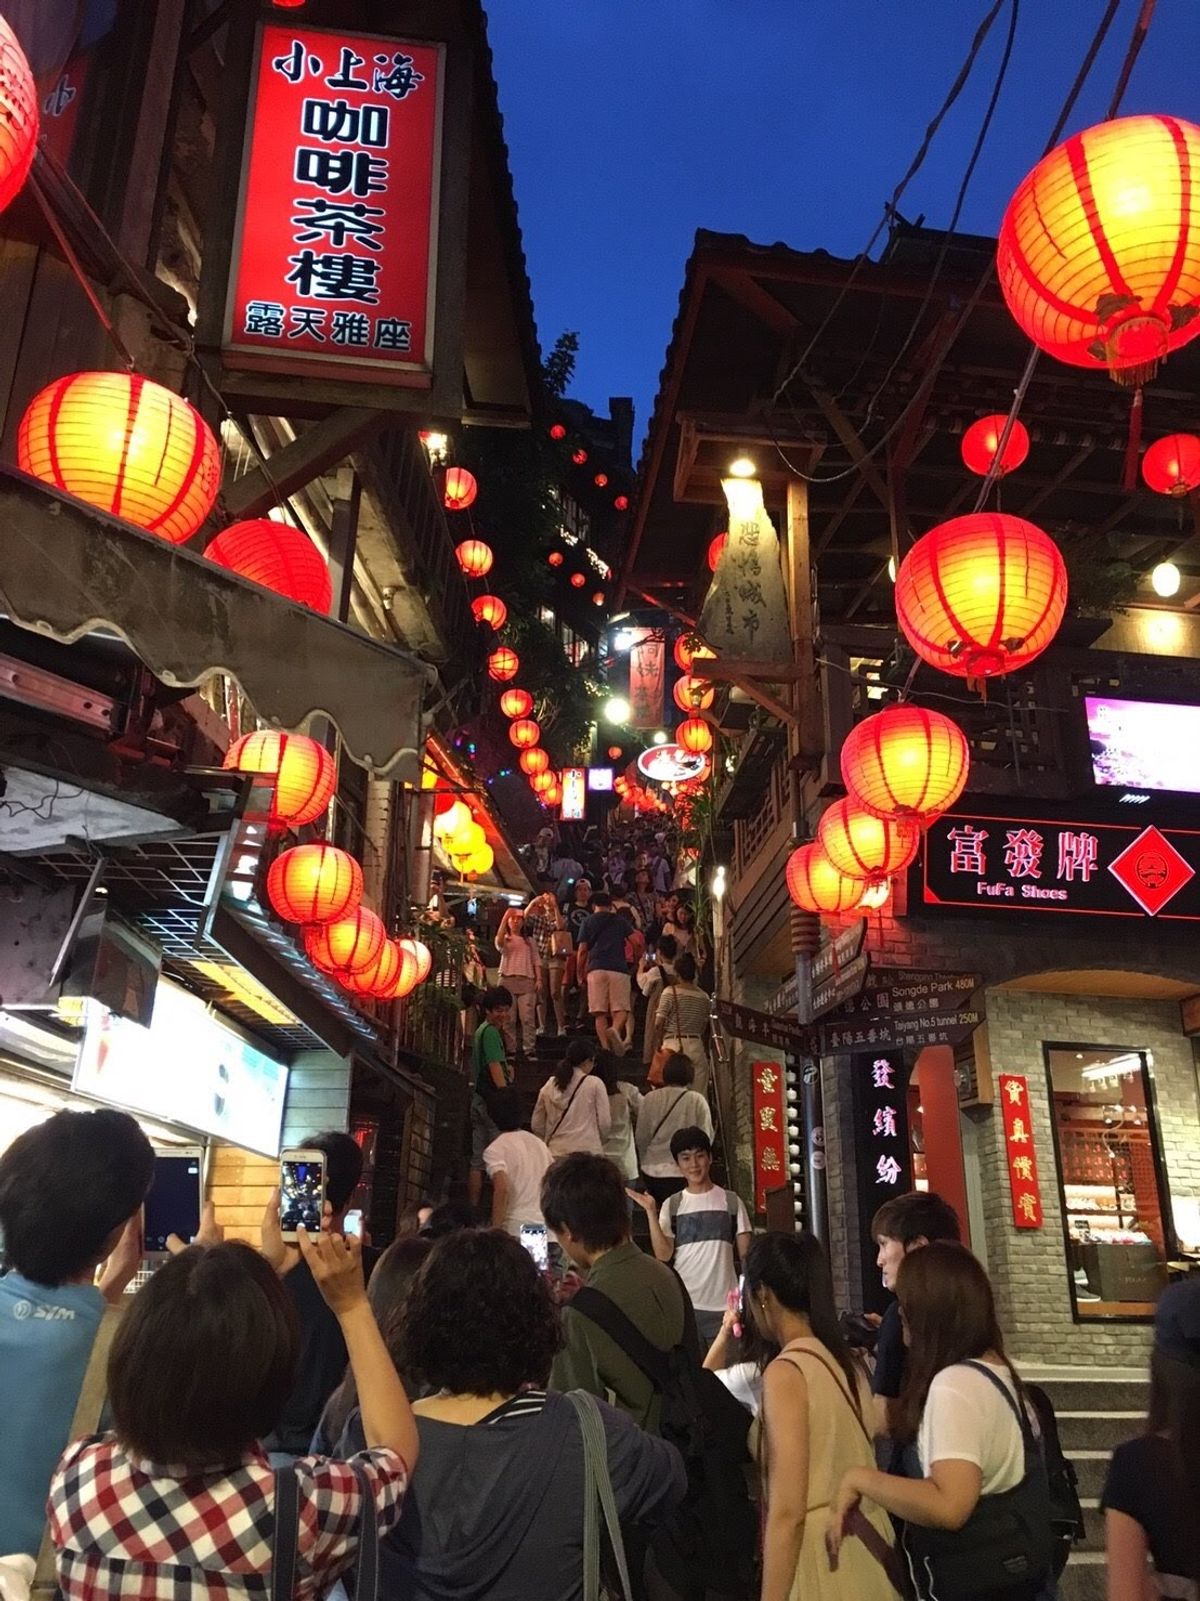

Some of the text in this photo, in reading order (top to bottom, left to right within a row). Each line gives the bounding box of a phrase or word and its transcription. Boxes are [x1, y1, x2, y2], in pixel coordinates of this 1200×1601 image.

[273, 40, 424, 99] 小上海
[285, 98, 390, 304] 咖啡茶樓
[245, 301, 412, 351] 露天雅座
[947, 825, 1099, 882] 富發牌
[977, 881, 1068, 900] FuFa Shoes
[892, 977, 975, 998] Songde Park 480M
[936, 1016, 957, 1026] tunnel
[958, 1012, 979, 1025] 250M
[757, 1067, 781, 1210] 童叟無
